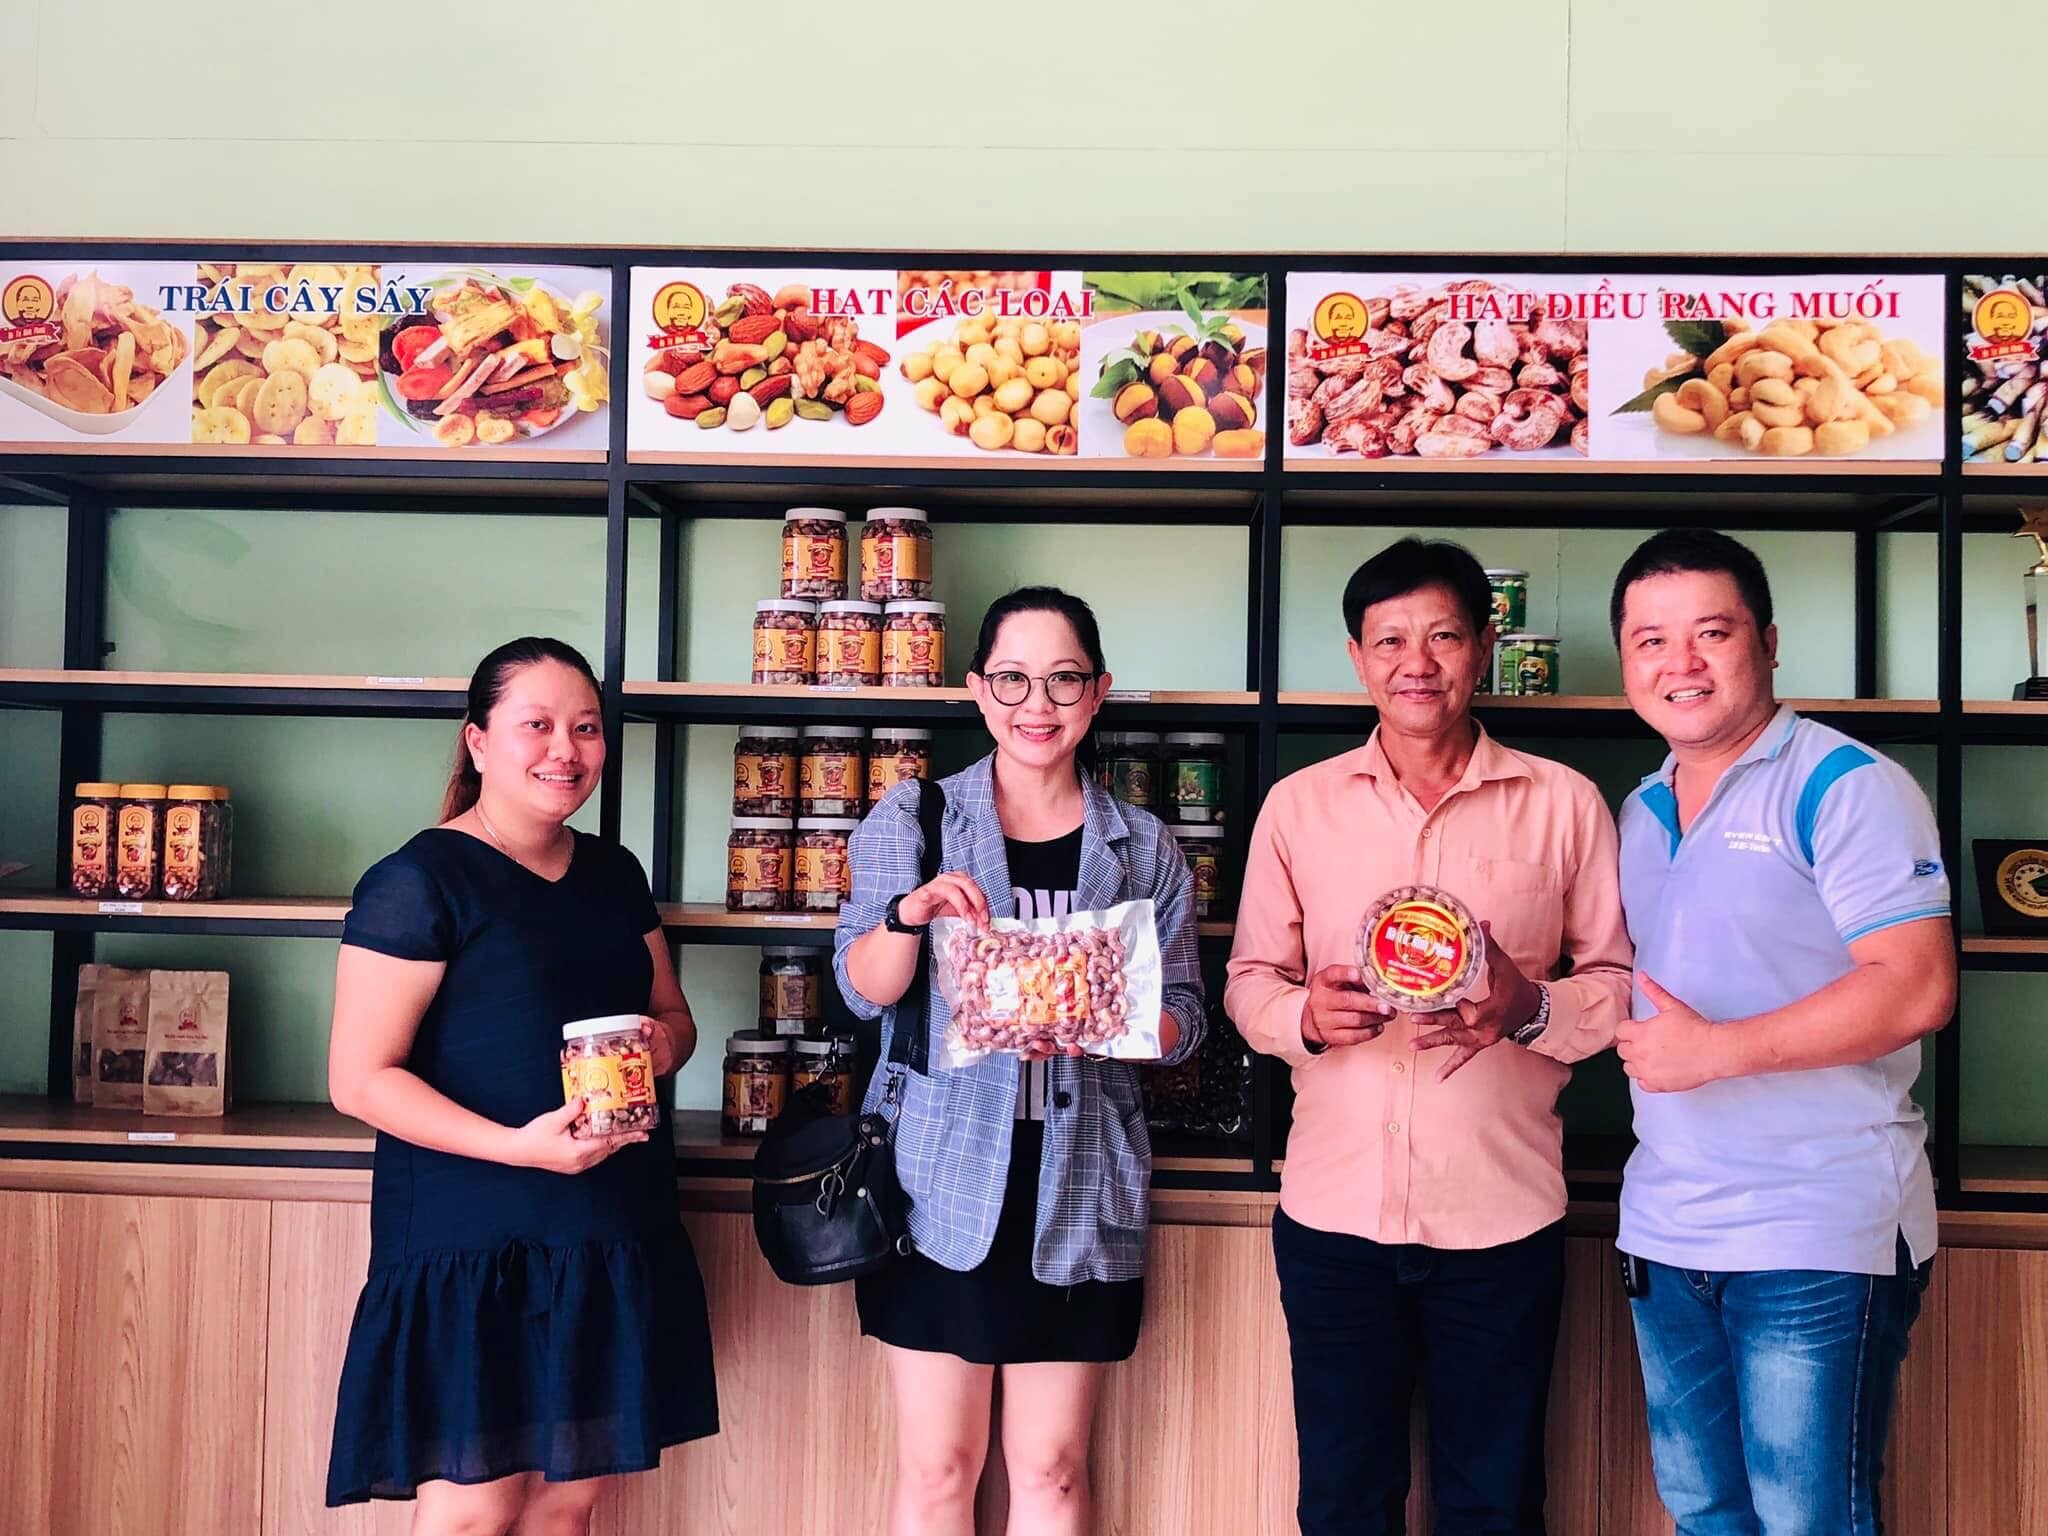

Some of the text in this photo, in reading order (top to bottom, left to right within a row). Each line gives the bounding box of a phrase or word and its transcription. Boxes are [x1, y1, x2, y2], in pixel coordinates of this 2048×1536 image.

[159, 275, 432, 315] TRÁI CÂY SẤY
[808, 281, 1094, 324] HẠT CÁC LOẠI
[1446, 277, 1901, 326] HẠT ĐIỀU RANG MUỐI
